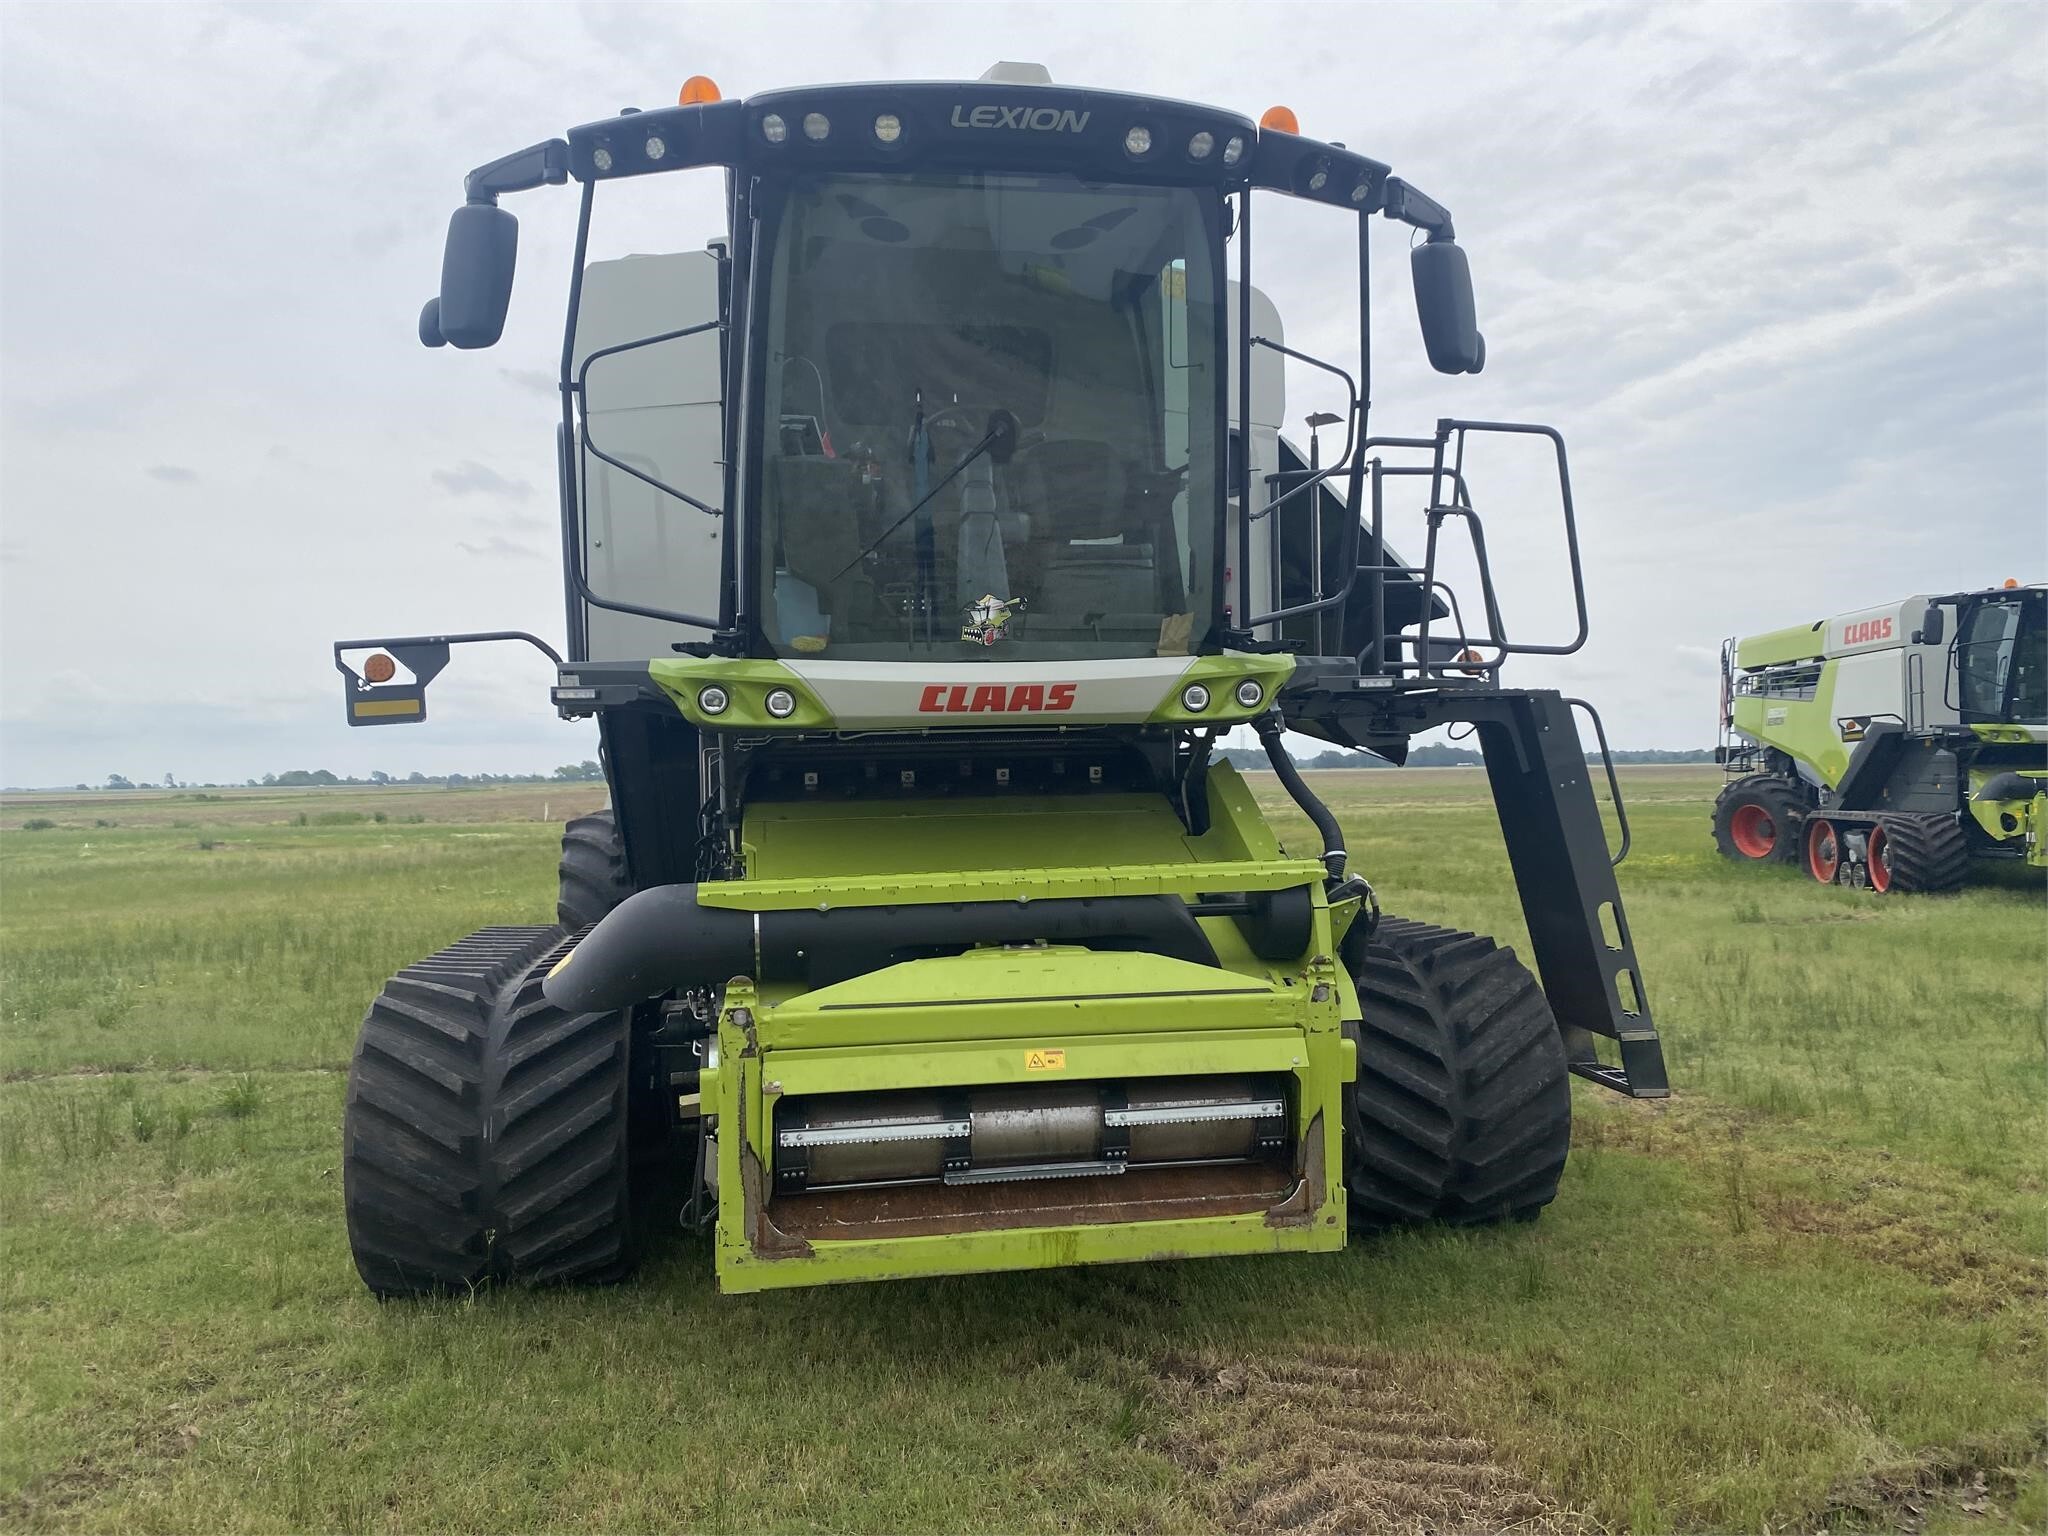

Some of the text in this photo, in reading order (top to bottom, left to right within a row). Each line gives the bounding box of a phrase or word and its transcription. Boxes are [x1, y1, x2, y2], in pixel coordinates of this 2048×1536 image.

[951, 105, 1090, 133] LEXION
[1844, 618, 1892, 645] CLAAS
[919, 684, 1077, 712] CLAAS
